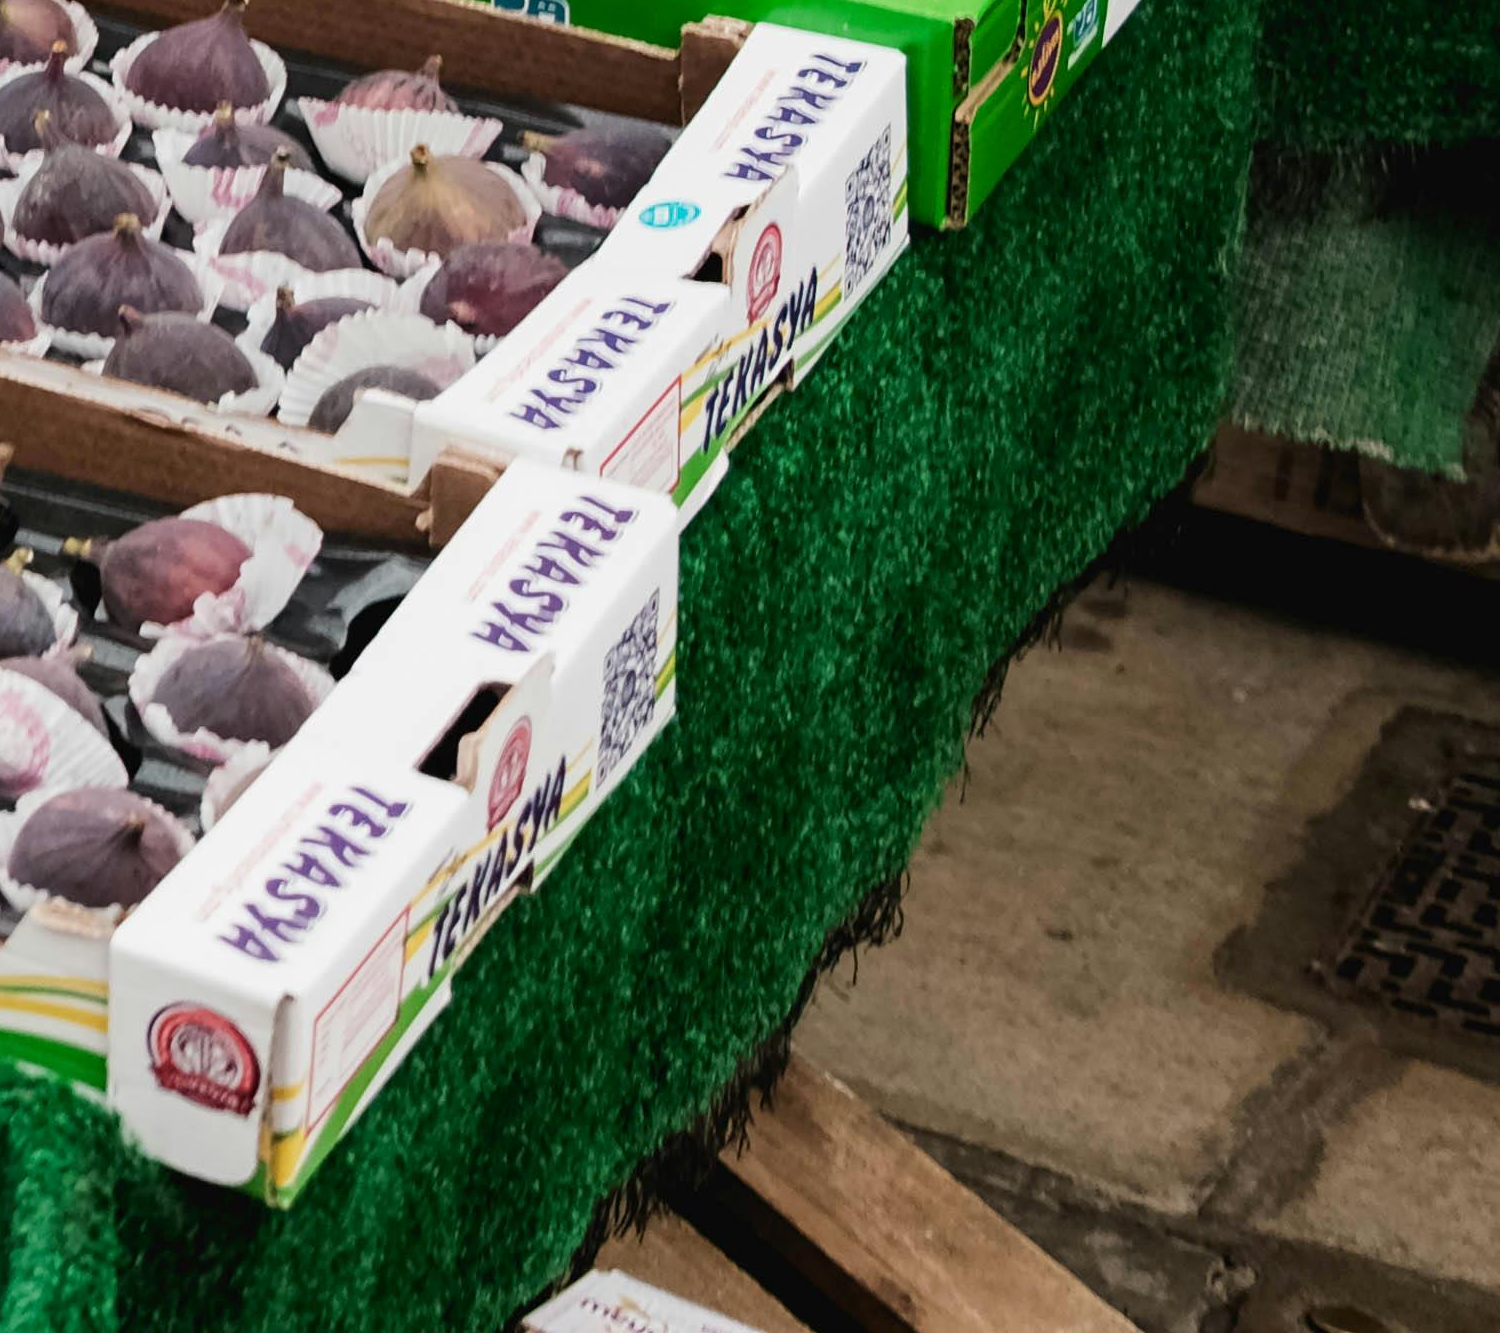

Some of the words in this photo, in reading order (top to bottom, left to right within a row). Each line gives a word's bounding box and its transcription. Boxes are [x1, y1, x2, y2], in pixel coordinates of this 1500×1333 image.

[724, 51, 866, 185] TEKASYA
[510, 296, 670, 433] TEKASYA
[702, 265, 820, 455] TEKASYA
[473, 493, 640, 655] TEKASYA
[217, 785, 412, 963] TEKASYA
[426, 755, 568, 981] TEKASYA
